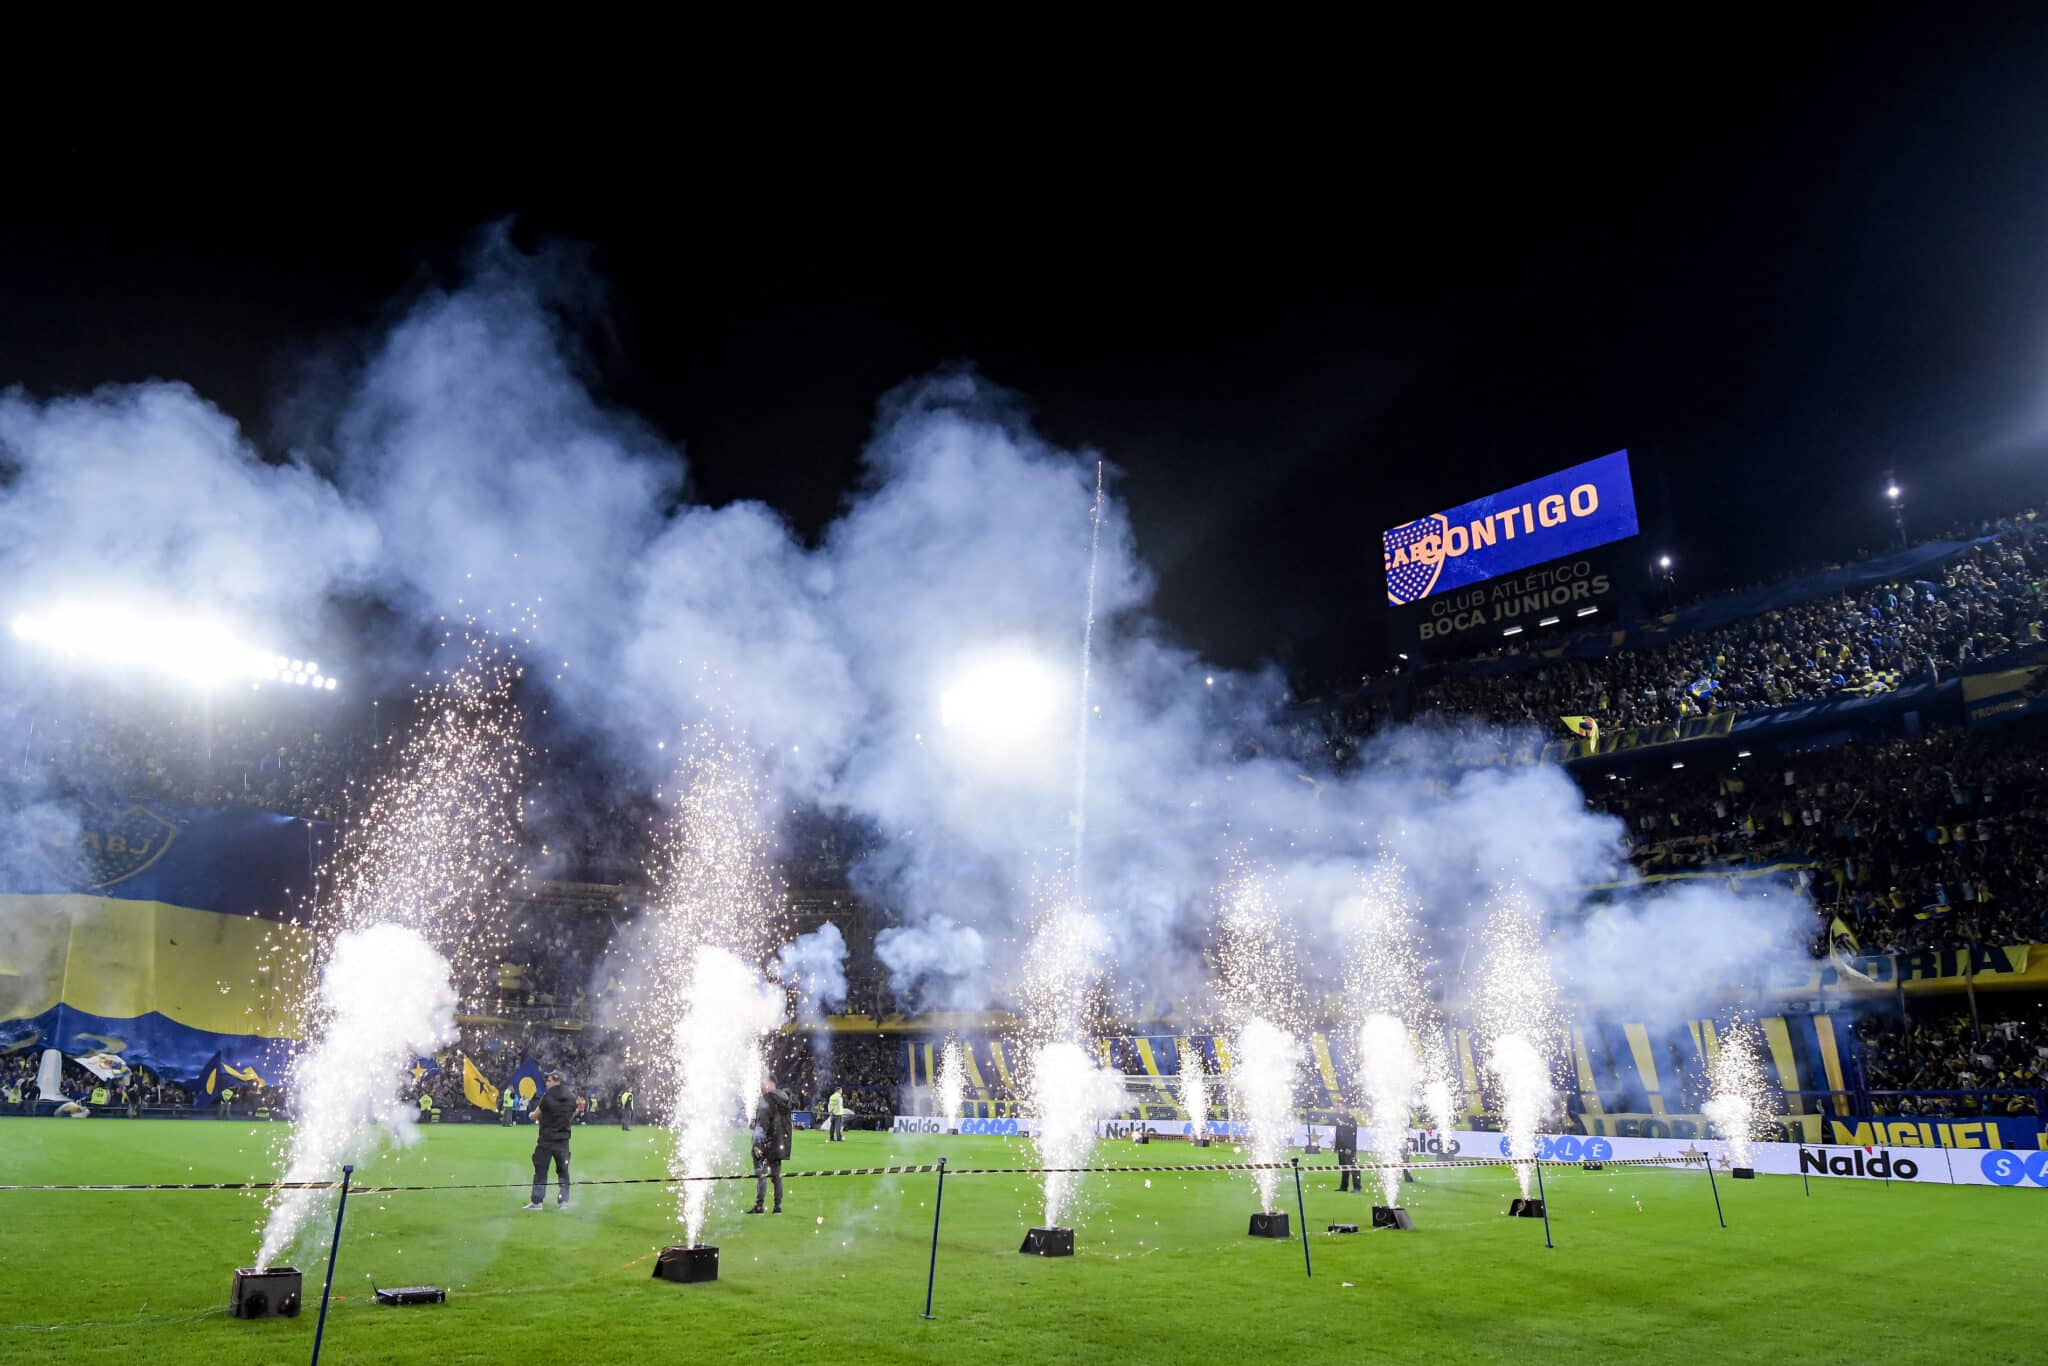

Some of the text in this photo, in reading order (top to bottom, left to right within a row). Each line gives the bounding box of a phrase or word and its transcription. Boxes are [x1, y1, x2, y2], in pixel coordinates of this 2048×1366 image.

[1419, 483, 1599, 566] CONTIGO
[1431, 560, 1591, 617] CLUB ATLÉTICO
[1419, 574, 1610, 641] BOCA JUNIORS
[898, 1119, 940, 1133] Naldo
[963, 1121, 1017, 1133] SALE
[1407, 1132, 1460, 1155] aldo
[1799, 1147, 1918, 1179] Naldo
